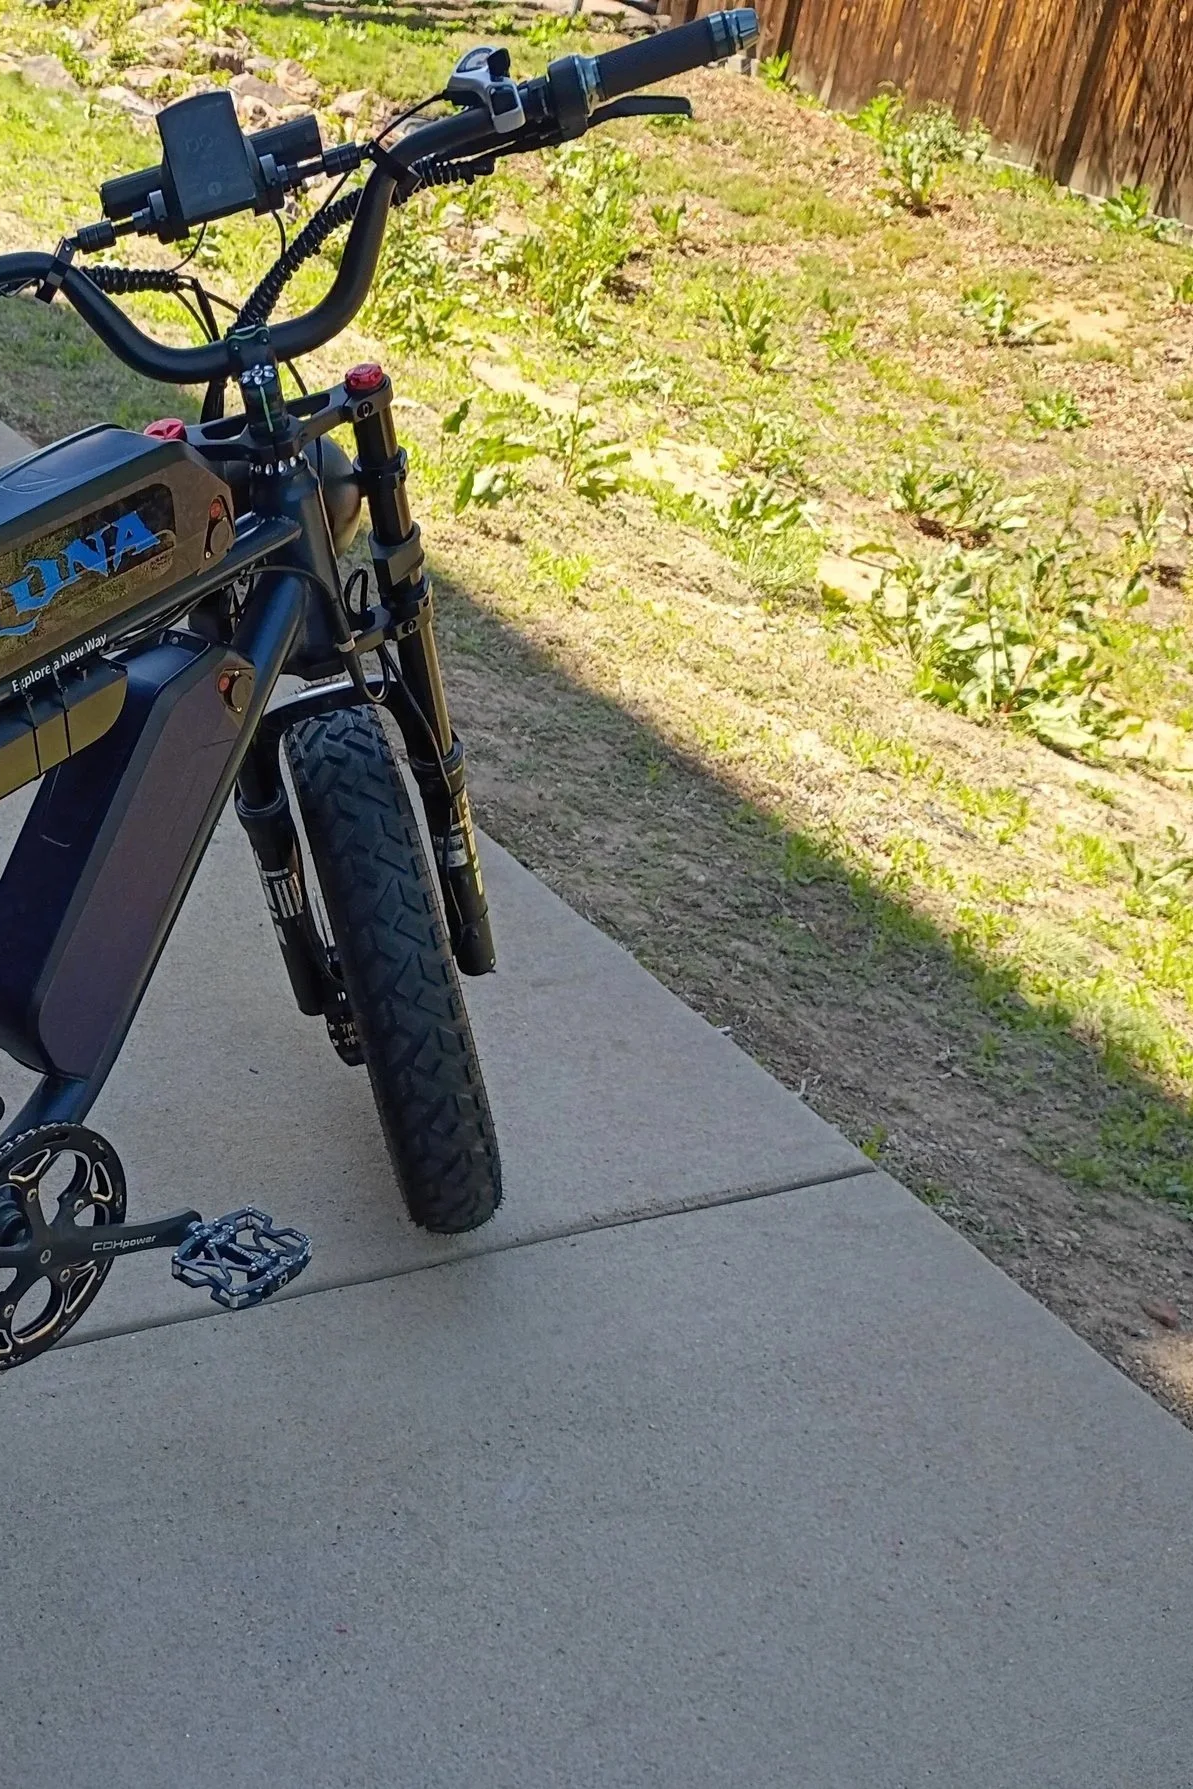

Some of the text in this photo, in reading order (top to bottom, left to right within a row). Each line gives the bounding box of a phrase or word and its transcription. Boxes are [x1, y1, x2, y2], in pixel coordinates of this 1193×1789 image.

[53, 660, 60, 670] a
[60, 647, 84, 666] New
[85, 633, 107, 652] Way
